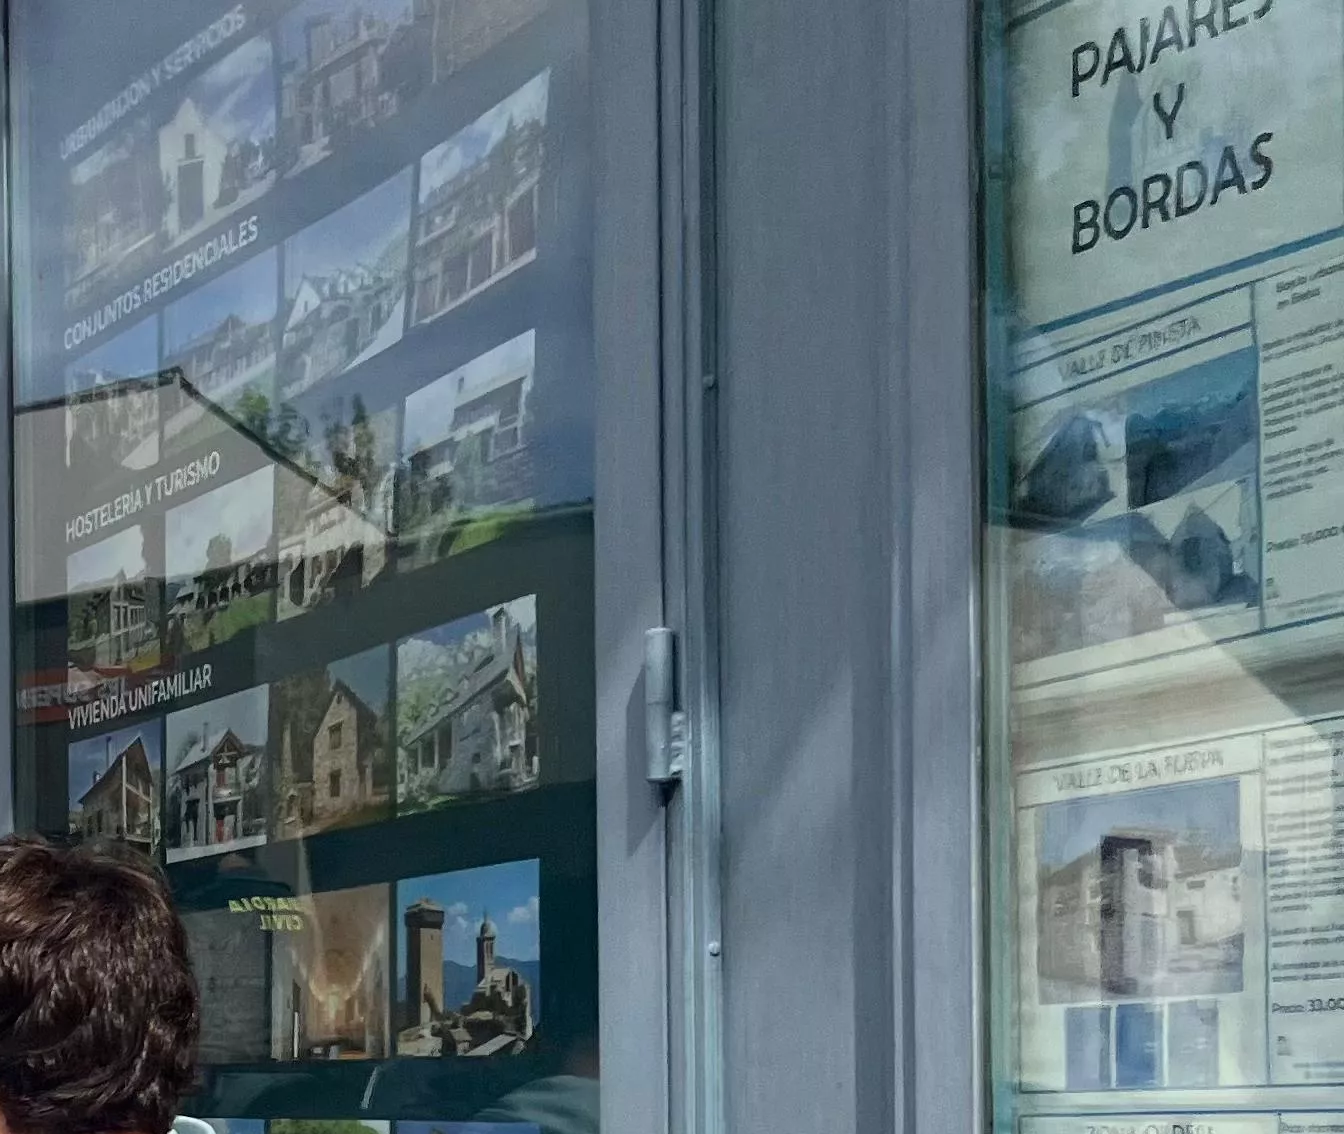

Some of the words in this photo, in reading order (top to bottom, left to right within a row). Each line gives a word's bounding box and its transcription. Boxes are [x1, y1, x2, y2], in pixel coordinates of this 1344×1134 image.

[1152, 83, 1185, 140] Y
[1071, 131, 1274, 254] BORDAS
[63, 285, 141, 350] CONJUNTOS
[142, 215, 258, 302] RESIDENCIALES
[65, 484, 143, 543] HOSTELERÍA
[144, 482, 153, 505] Y
[155, 451, 220, 501] TURISMO
[68, 696, 126, 730] VIVIENDA
[129, 664, 213, 711] UNIFAMILIAR
